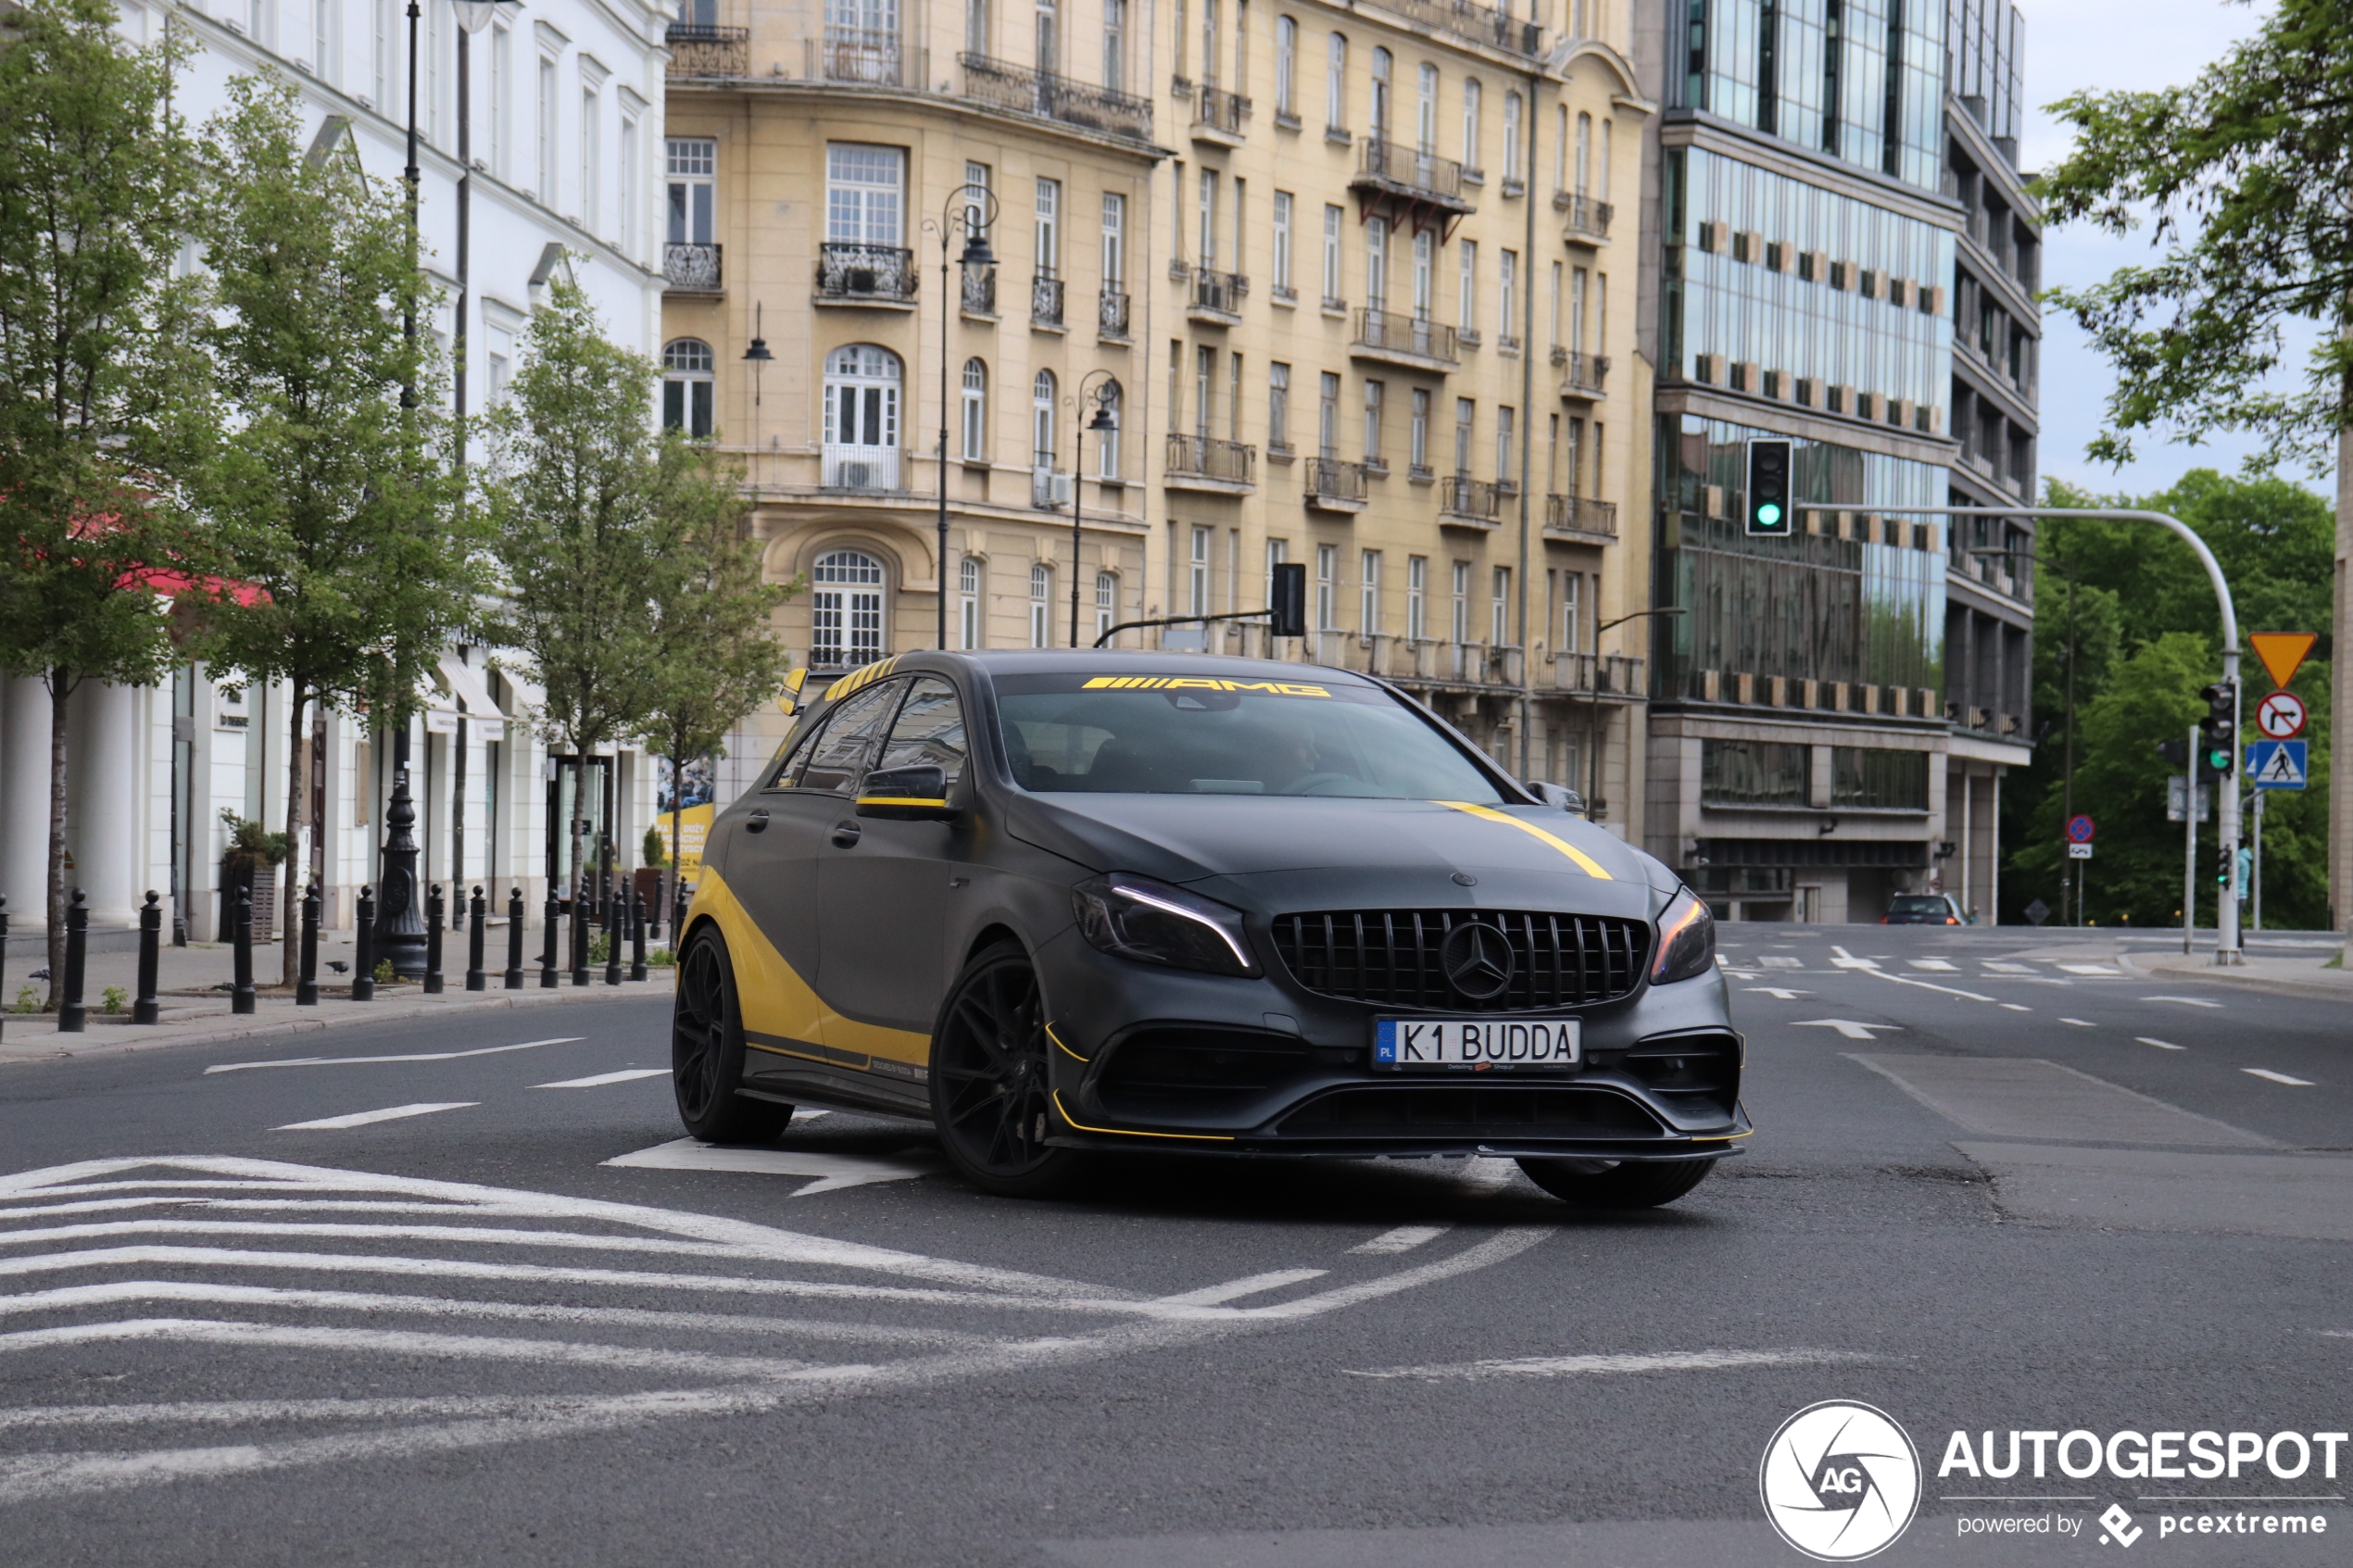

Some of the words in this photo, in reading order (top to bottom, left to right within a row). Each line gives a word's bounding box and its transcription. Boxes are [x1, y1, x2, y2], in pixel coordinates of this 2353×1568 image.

[1164, 678, 1332, 697] AMG
[1404, 1024, 1442, 1060] K1
[1462, 1024, 1572, 1060] BUDDA
[1380, 1047, 1392, 1057] PL
